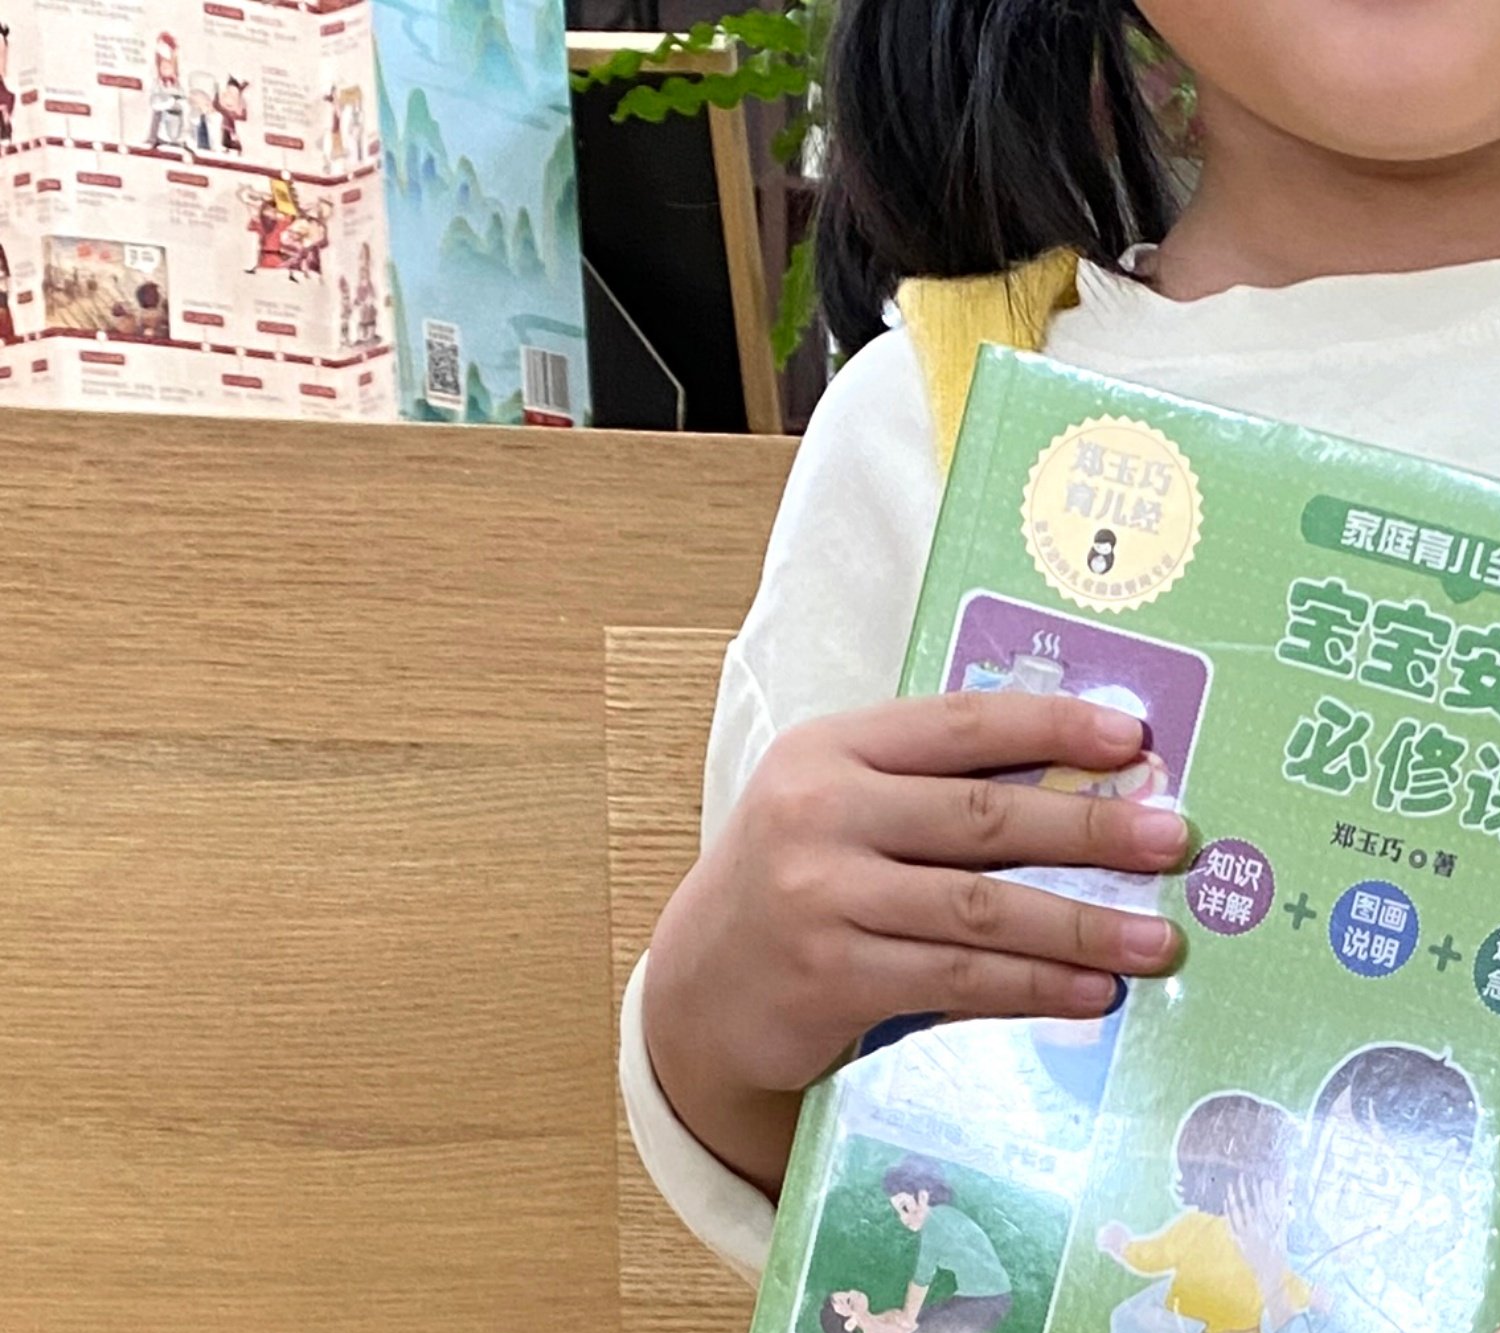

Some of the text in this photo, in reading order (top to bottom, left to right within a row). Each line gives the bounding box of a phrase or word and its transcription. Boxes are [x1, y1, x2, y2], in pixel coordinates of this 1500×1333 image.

[1069, 438, 1175, 496] 郑玉巧
[1064, 481, 1163, 535] 育儿经
[1330, 820, 1406, 864] 郑玉巧
[1204, 847, 1264, 892] 知识
[1196, 883, 1255, 927] 详解
[1350, 891, 1411, 933] 图画
[1340, 926, 1401, 969] 说明
